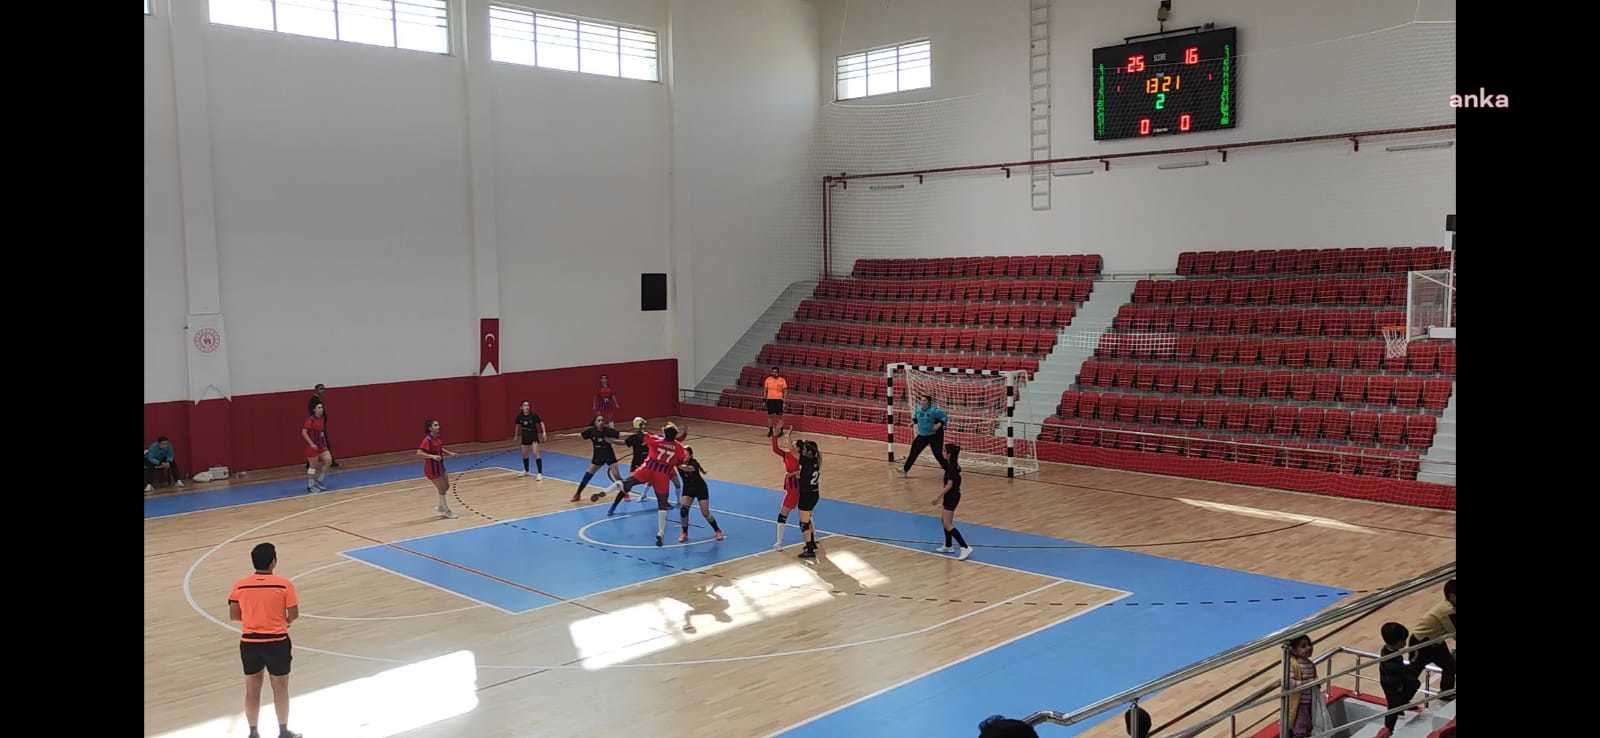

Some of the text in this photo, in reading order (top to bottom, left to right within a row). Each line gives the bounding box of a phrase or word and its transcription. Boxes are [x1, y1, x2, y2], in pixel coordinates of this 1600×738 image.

[1185, 47, 1198, 64] 16
[1127, 55, 1144, 73] 25
[1155, 93, 1165, 109] 2
[1140, 119, 1150, 134] 0
[1180, 115, 1190, 131] 0
[657, 447, 675, 463] 77
